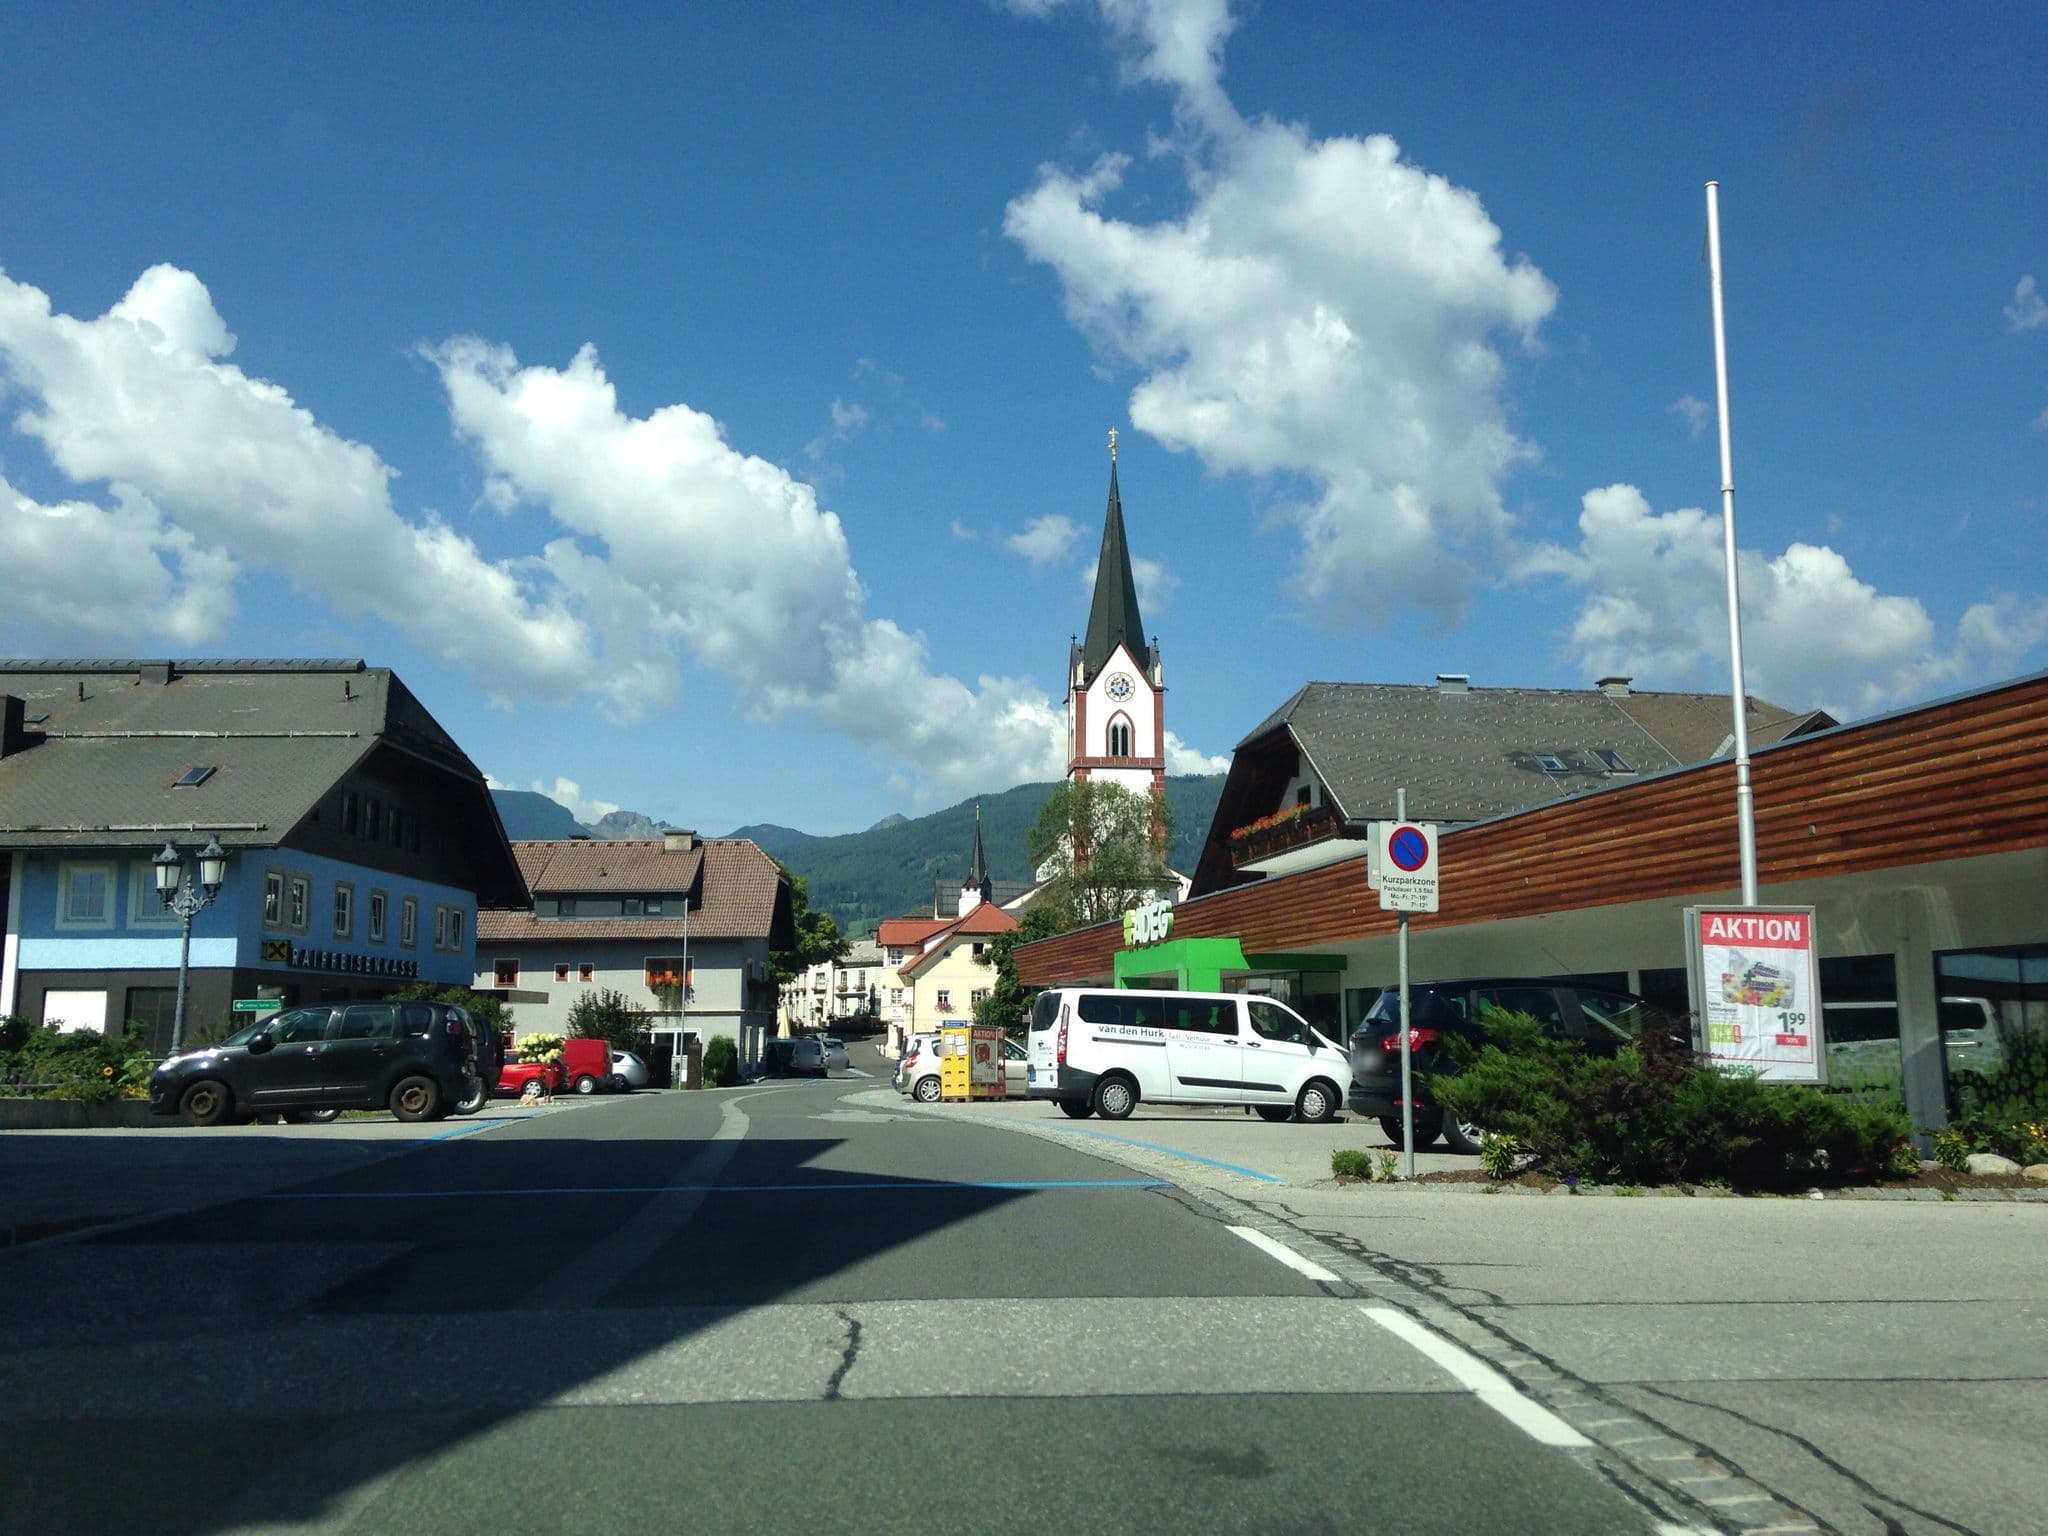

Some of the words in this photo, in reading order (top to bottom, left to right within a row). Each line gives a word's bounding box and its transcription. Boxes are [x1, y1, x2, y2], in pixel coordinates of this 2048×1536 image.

[1382, 875, 1436, 886] Kurzparkzone
[1133, 900, 1174, 945] ADEG
[1709, 917, 1801, 942] AKTION
[291, 949, 421, 977] RAIFFEISENKASSE
[973, 1029, 996, 1039] AKTION
[1098, 1025, 1117, 1034] van
[1119, 1026, 1138, 1036] den
[1140, 1028, 1165, 1039] Hurk
